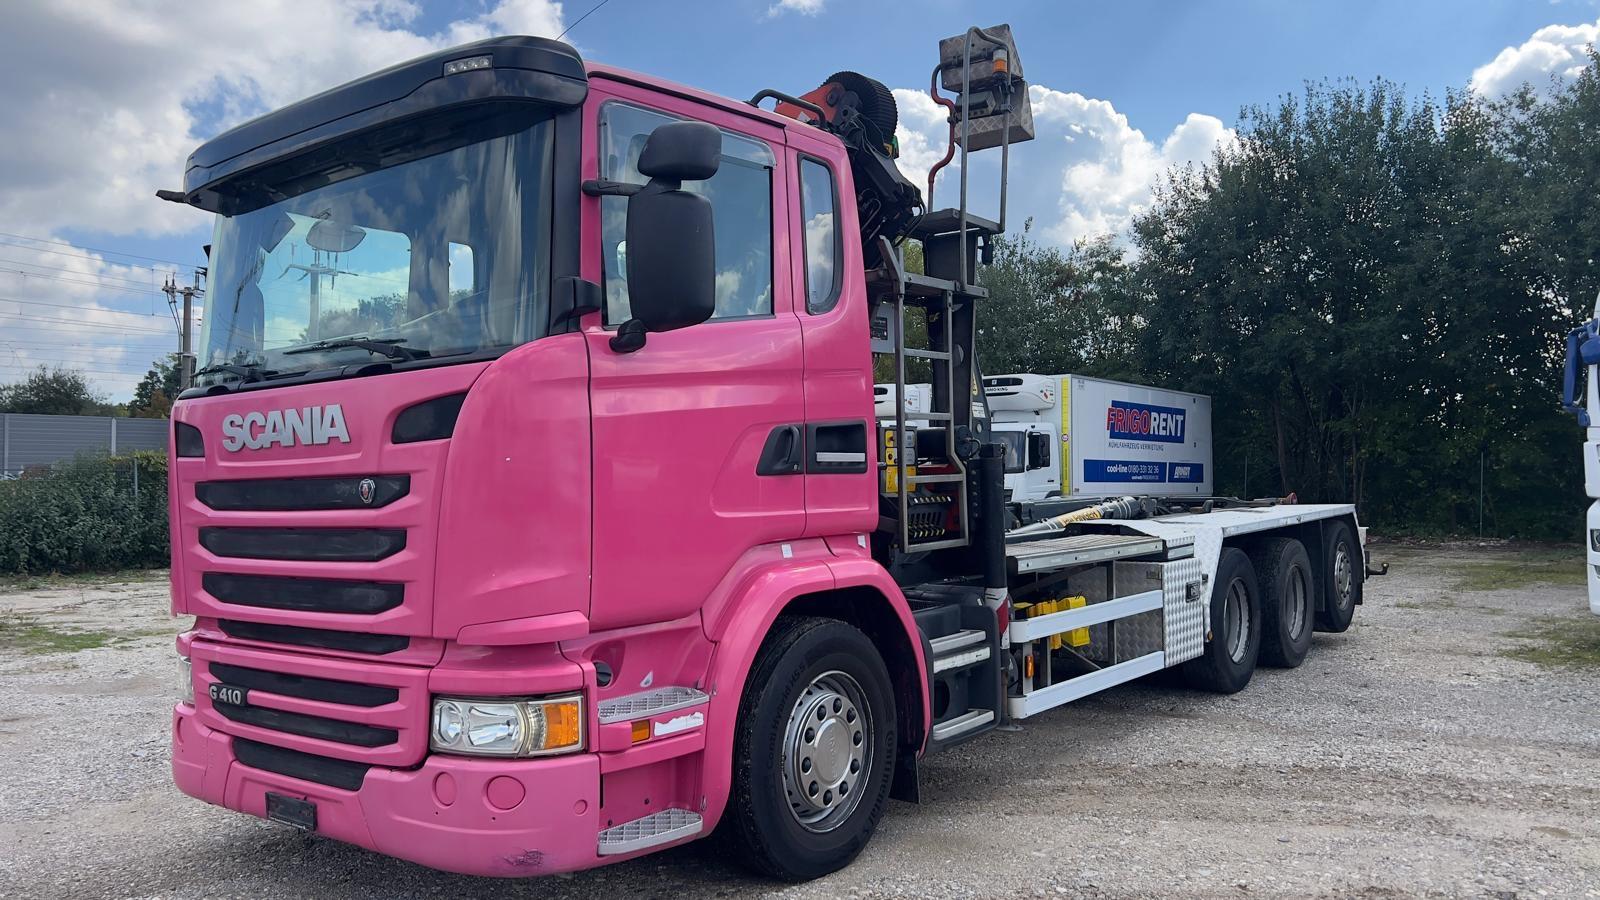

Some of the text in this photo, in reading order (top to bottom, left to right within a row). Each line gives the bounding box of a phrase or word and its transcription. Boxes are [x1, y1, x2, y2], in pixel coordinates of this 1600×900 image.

[222, 403, 351, 452] SCANIA
[1106, 406, 1184, 437] FRIGORENT
[1106, 464, 1127, 473] cool-line
[209, 685, 241, 705] G 410
[771, 685, 791, 729] Hybrid
[766, 732, 777, 770] Conti
[868, 730, 895, 825] Continental
